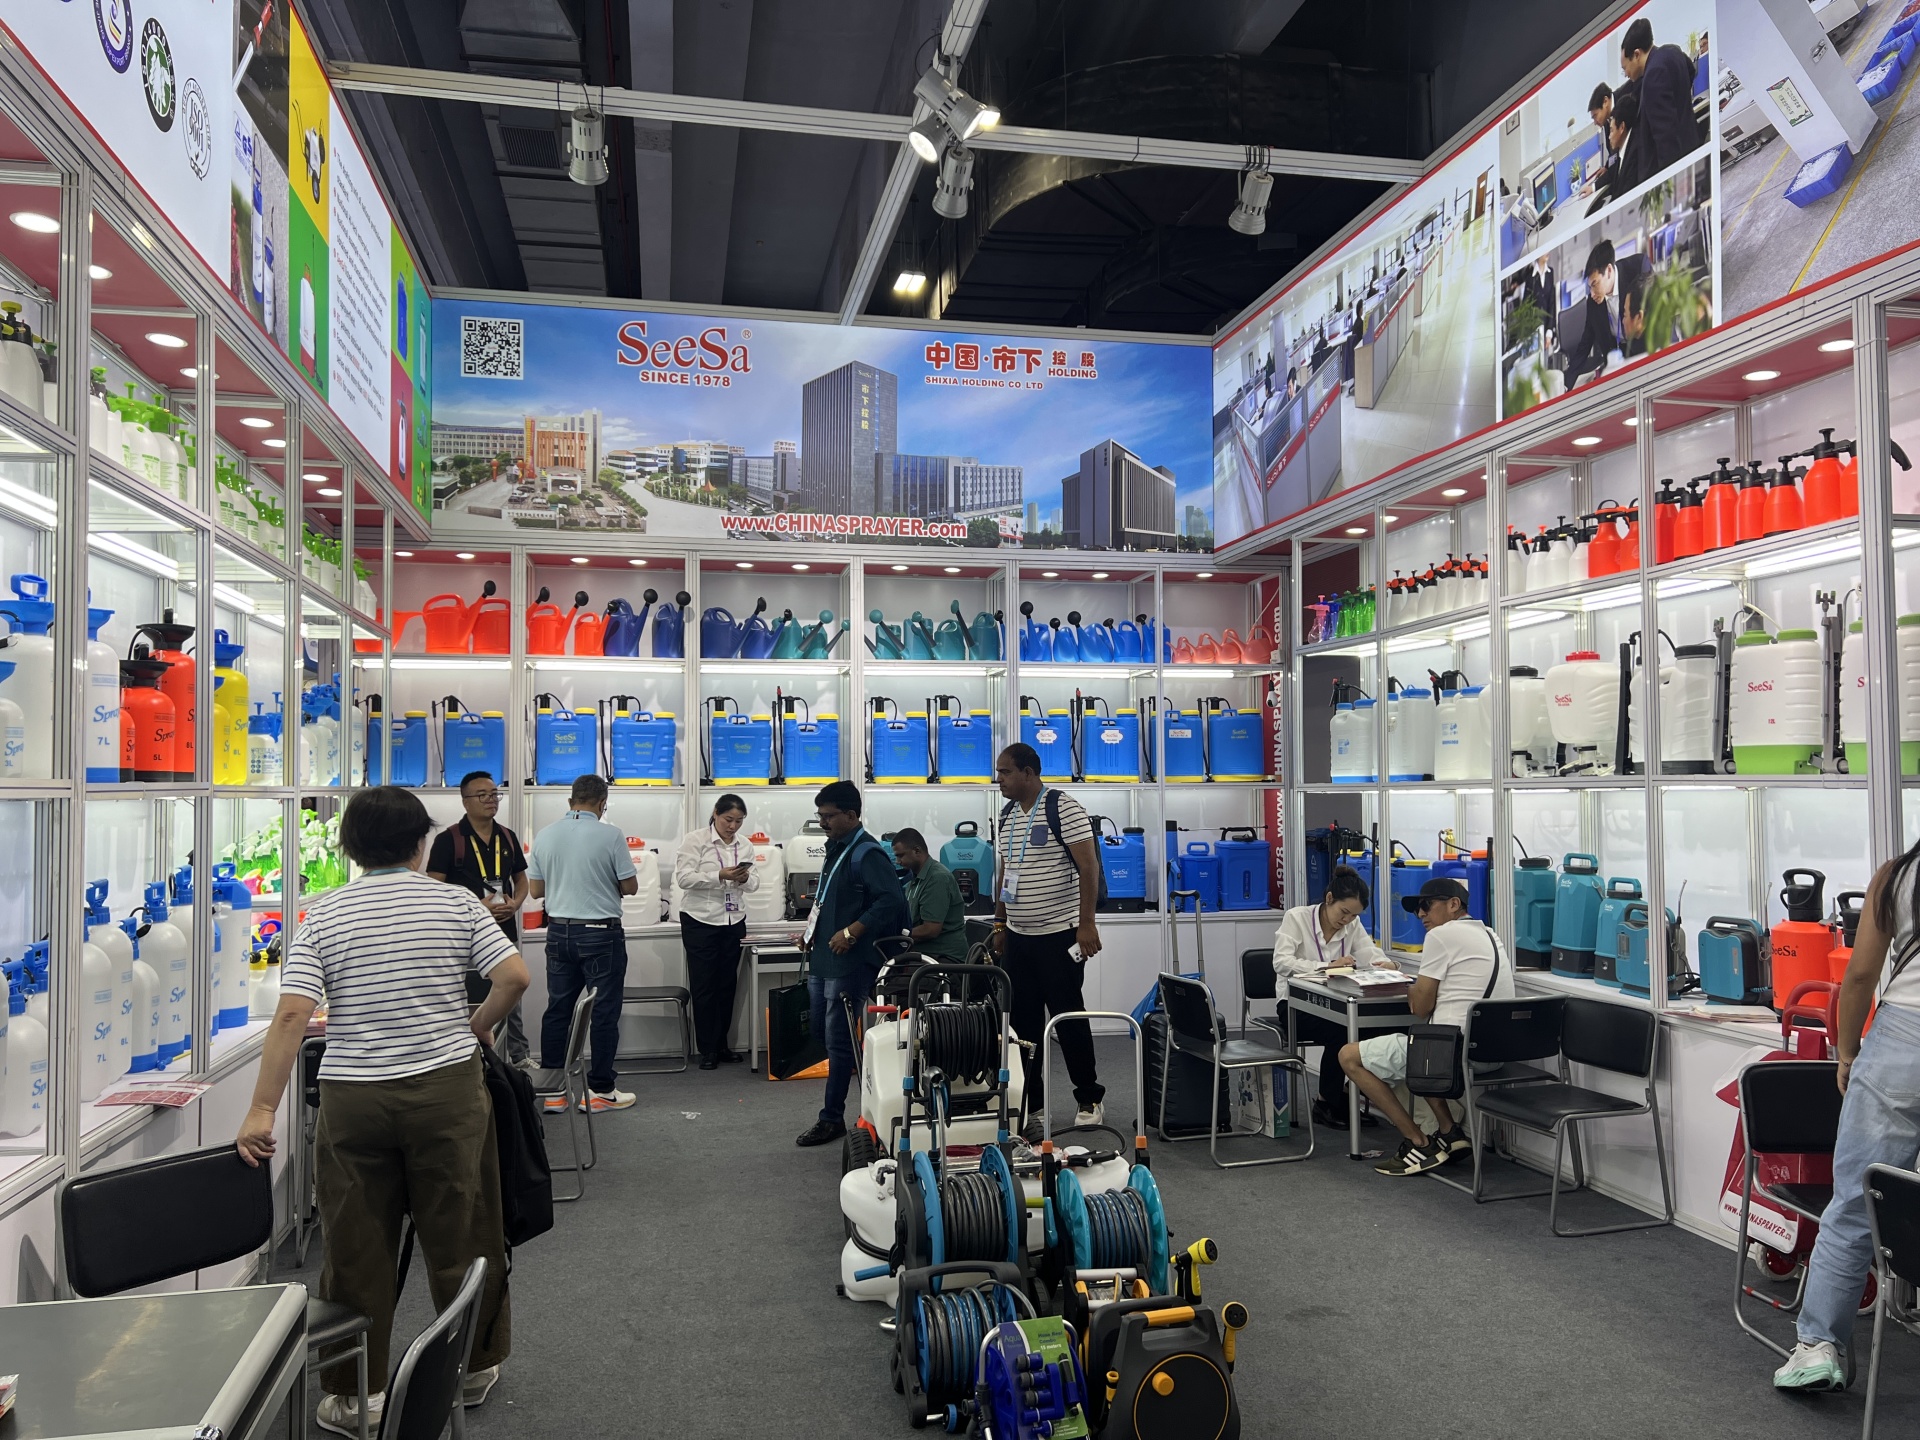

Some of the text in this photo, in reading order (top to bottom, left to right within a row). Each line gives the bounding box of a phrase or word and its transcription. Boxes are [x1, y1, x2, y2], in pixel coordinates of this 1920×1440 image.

[618, 322, 751, 373] SeeSa
[926, 342, 1042, 374] 中国·市下
[640, 371, 731, 387] SINCE 1978
[1048, 368, 1097, 379] HOLDING
[925, 376, 958, 385] SHIXIA
[962, 378, 1005, 388] HOLDING
[721, 514, 967, 537] www.CHINASPRAYER.com
[1748, 681, 1773, 692] SeeSa
[98, 737, 110, 745] 7L
[555, 733, 576, 741] SeeSa
[172, 1014, 181, 1022] 7L
[97, 1054, 106, 1063] 7L
